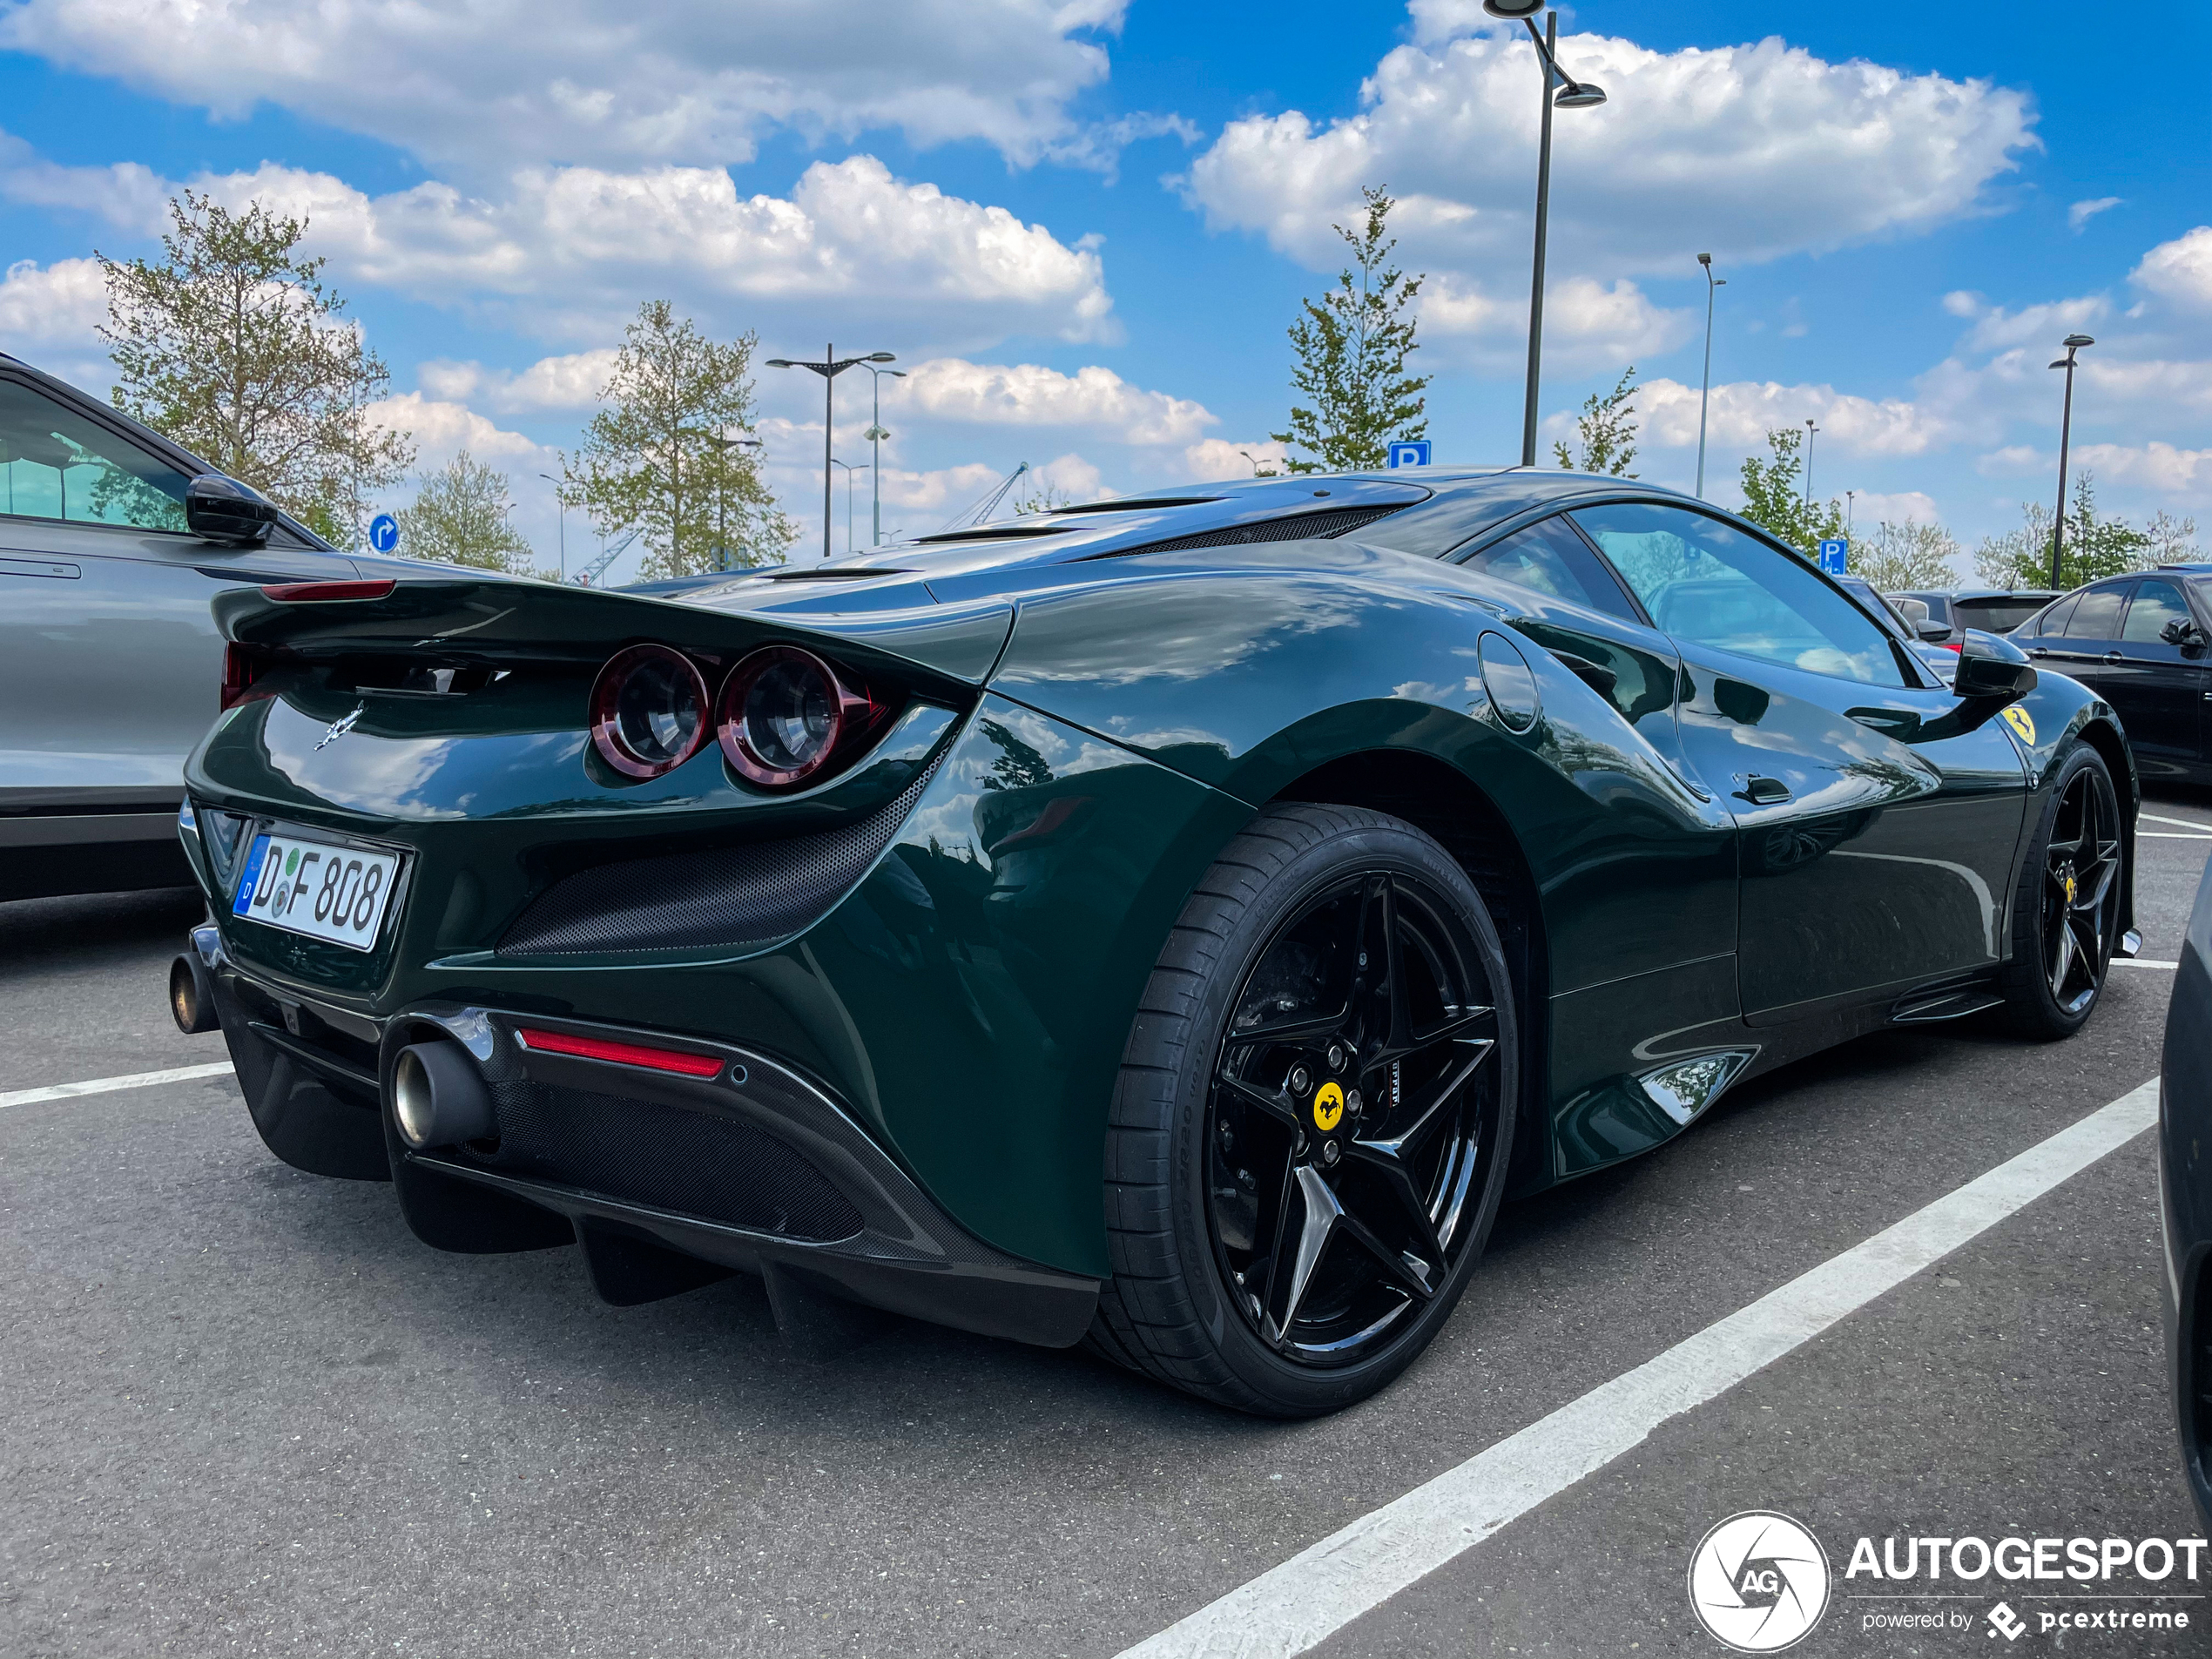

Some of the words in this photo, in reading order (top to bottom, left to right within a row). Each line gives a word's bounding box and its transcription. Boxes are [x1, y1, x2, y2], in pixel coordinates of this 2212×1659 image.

[1825, 543, 1840, 562] P
[243, 882, 252, 899] D
[314, 856, 383, 931] 808
